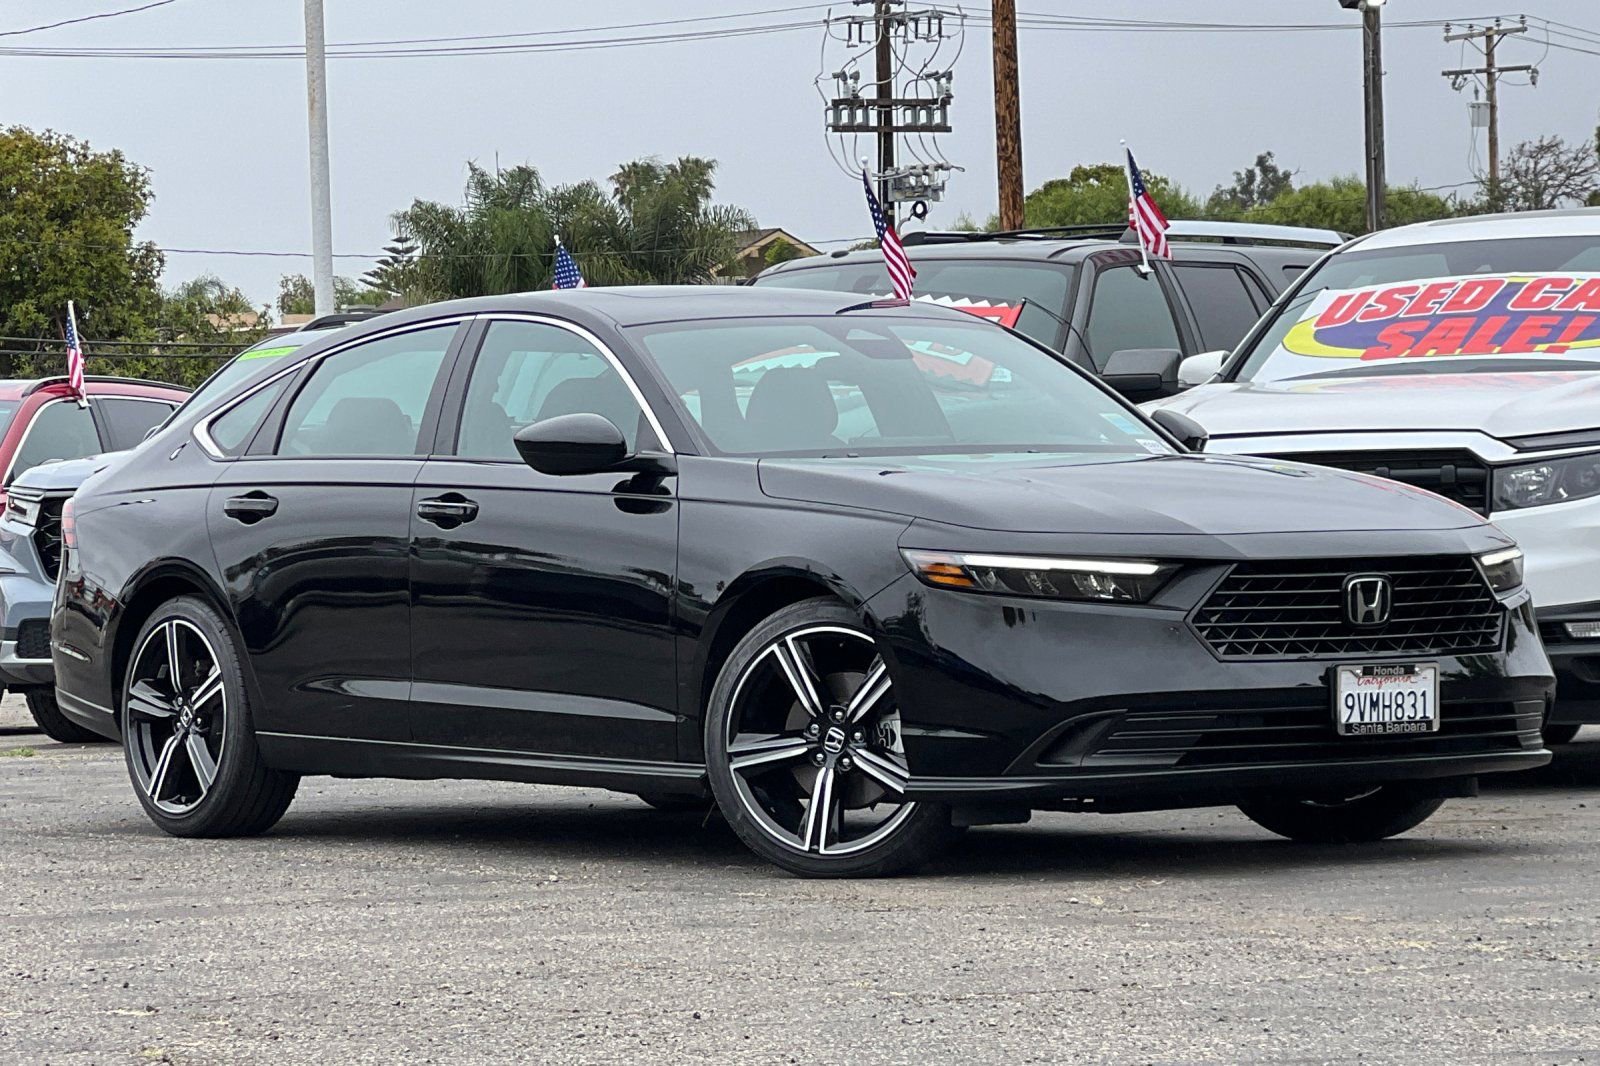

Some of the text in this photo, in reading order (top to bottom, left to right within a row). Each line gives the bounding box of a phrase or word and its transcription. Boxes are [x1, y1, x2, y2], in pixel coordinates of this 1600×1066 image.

[1313, 278, 1506, 329] USED
[1360, 315, 1597, 361] SALE!
[1373, 665, 1405, 675] Honda
[1357, 675, 1417, 689] California
[1344, 690, 1430, 722] 9VMH831
[1352, 721, 1427, 734] Santa Barbara
